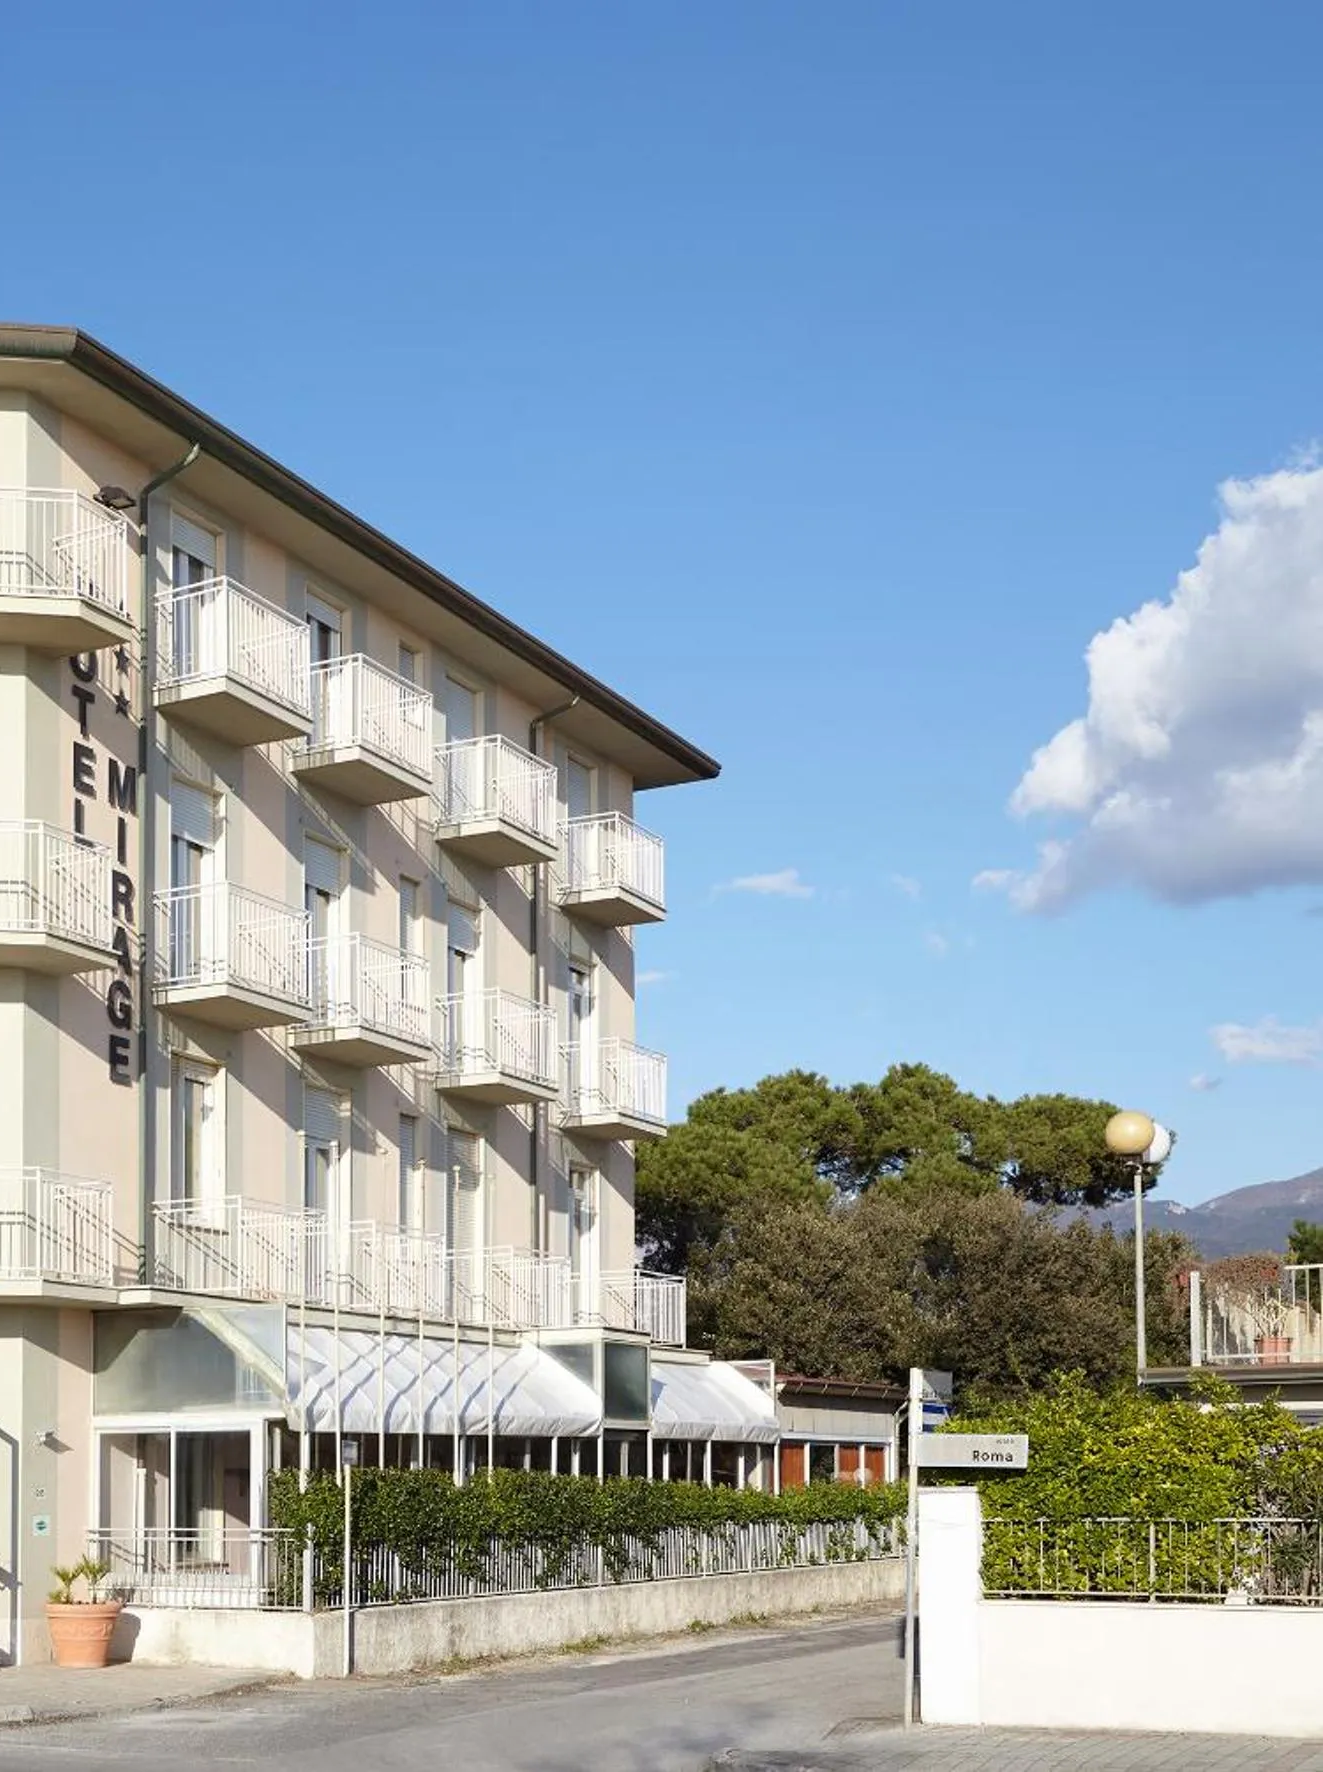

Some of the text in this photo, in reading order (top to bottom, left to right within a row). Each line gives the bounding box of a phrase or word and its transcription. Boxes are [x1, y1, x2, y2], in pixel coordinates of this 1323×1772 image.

[70, 576, 98, 848] OTEL
[107, 757, 138, 1086] MIRAGE
[973, 1450, 1013, 1462] Roma
